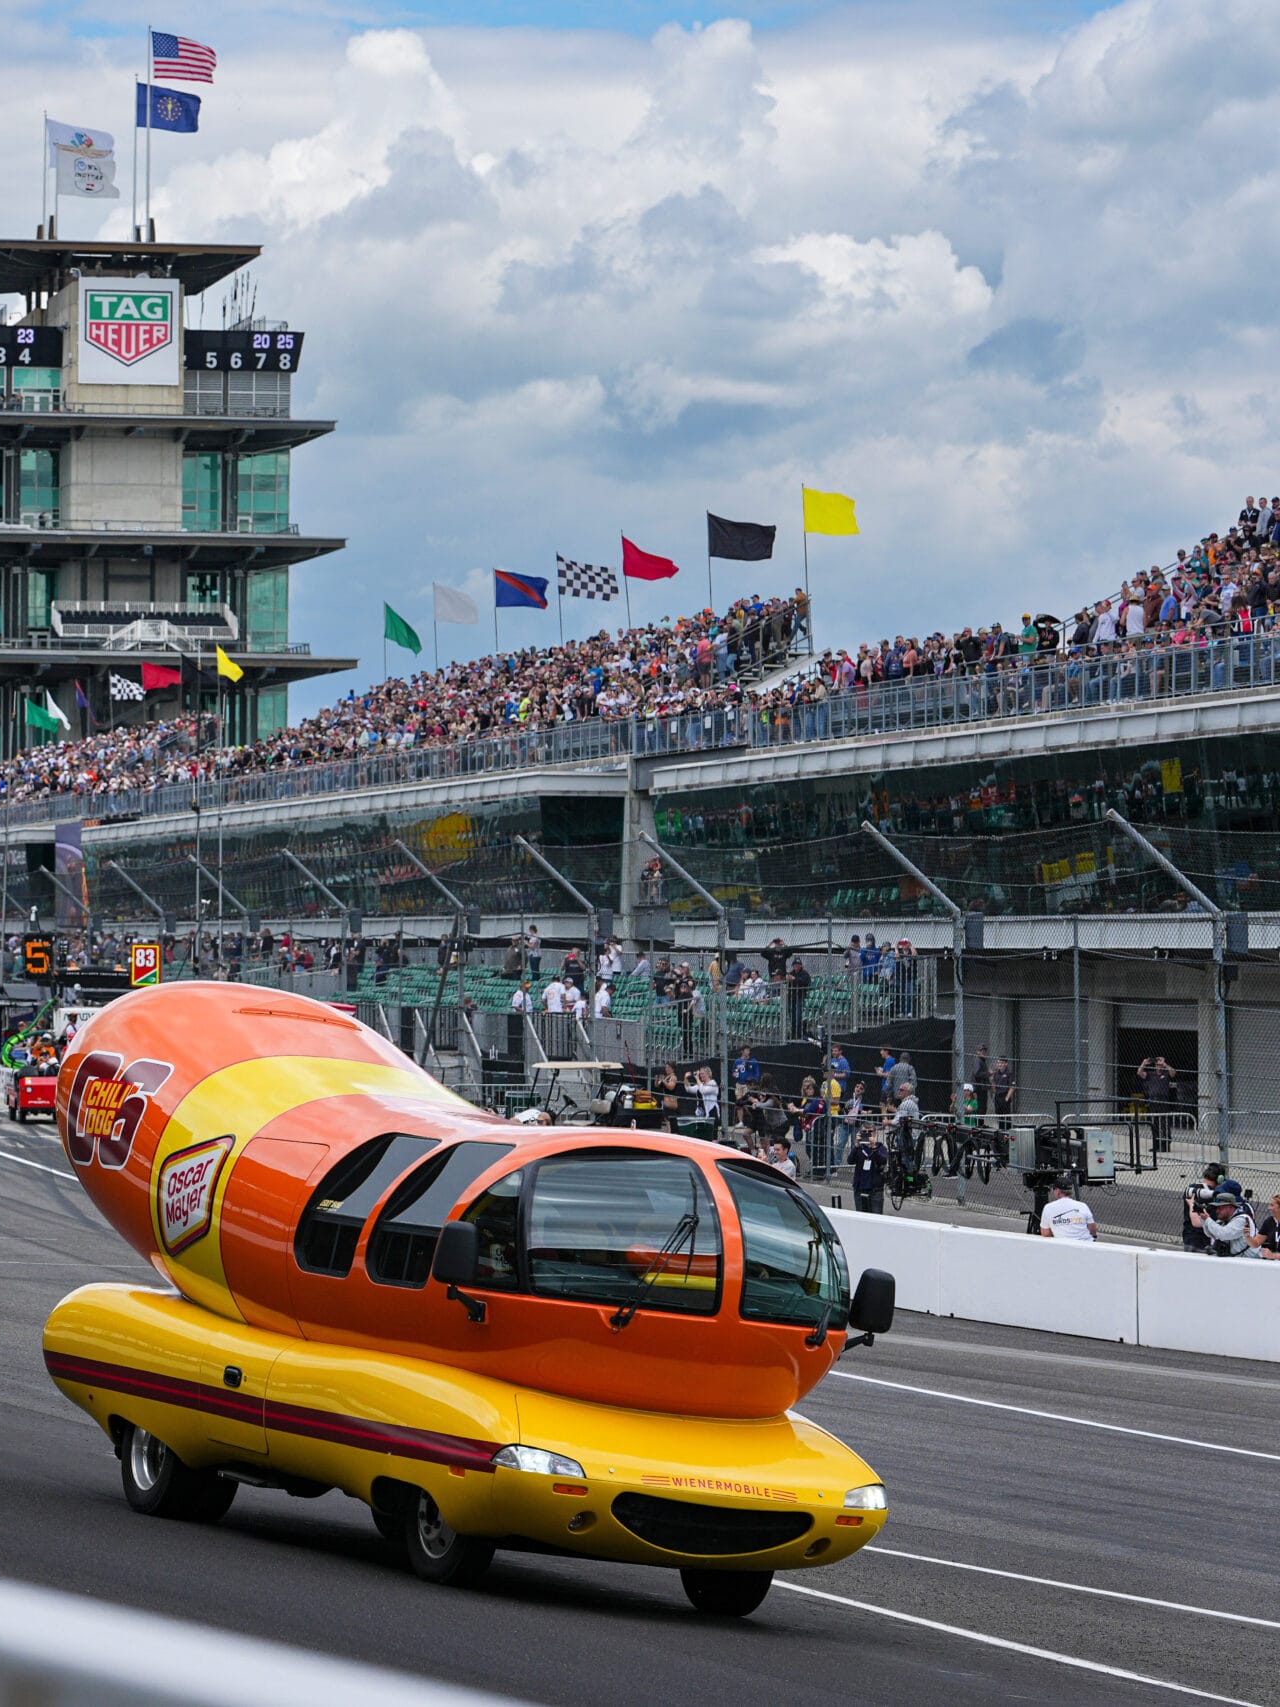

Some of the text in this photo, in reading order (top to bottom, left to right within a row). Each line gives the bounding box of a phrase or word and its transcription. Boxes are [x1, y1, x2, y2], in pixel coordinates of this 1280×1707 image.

[93, 295, 163, 319] TAG
[17, 328, 35, 343] 23
[91, 323, 166, 358] HEUER
[253, 334, 294, 349] 20 25
[18, 347, 31, 364] 4
[205, 352, 291, 369] 5 6 7 8
[25, 940, 50, 974] 5
[135, 948, 156, 968] 83
[86, 1080, 132, 1109] CHILI
[85, 1107, 116, 1136] DOG
[167, 1158, 215, 1199] Oscar
[165, 1184, 207, 1229] Mayer
[671, 1476, 771, 1498] WIENERMOBILE
